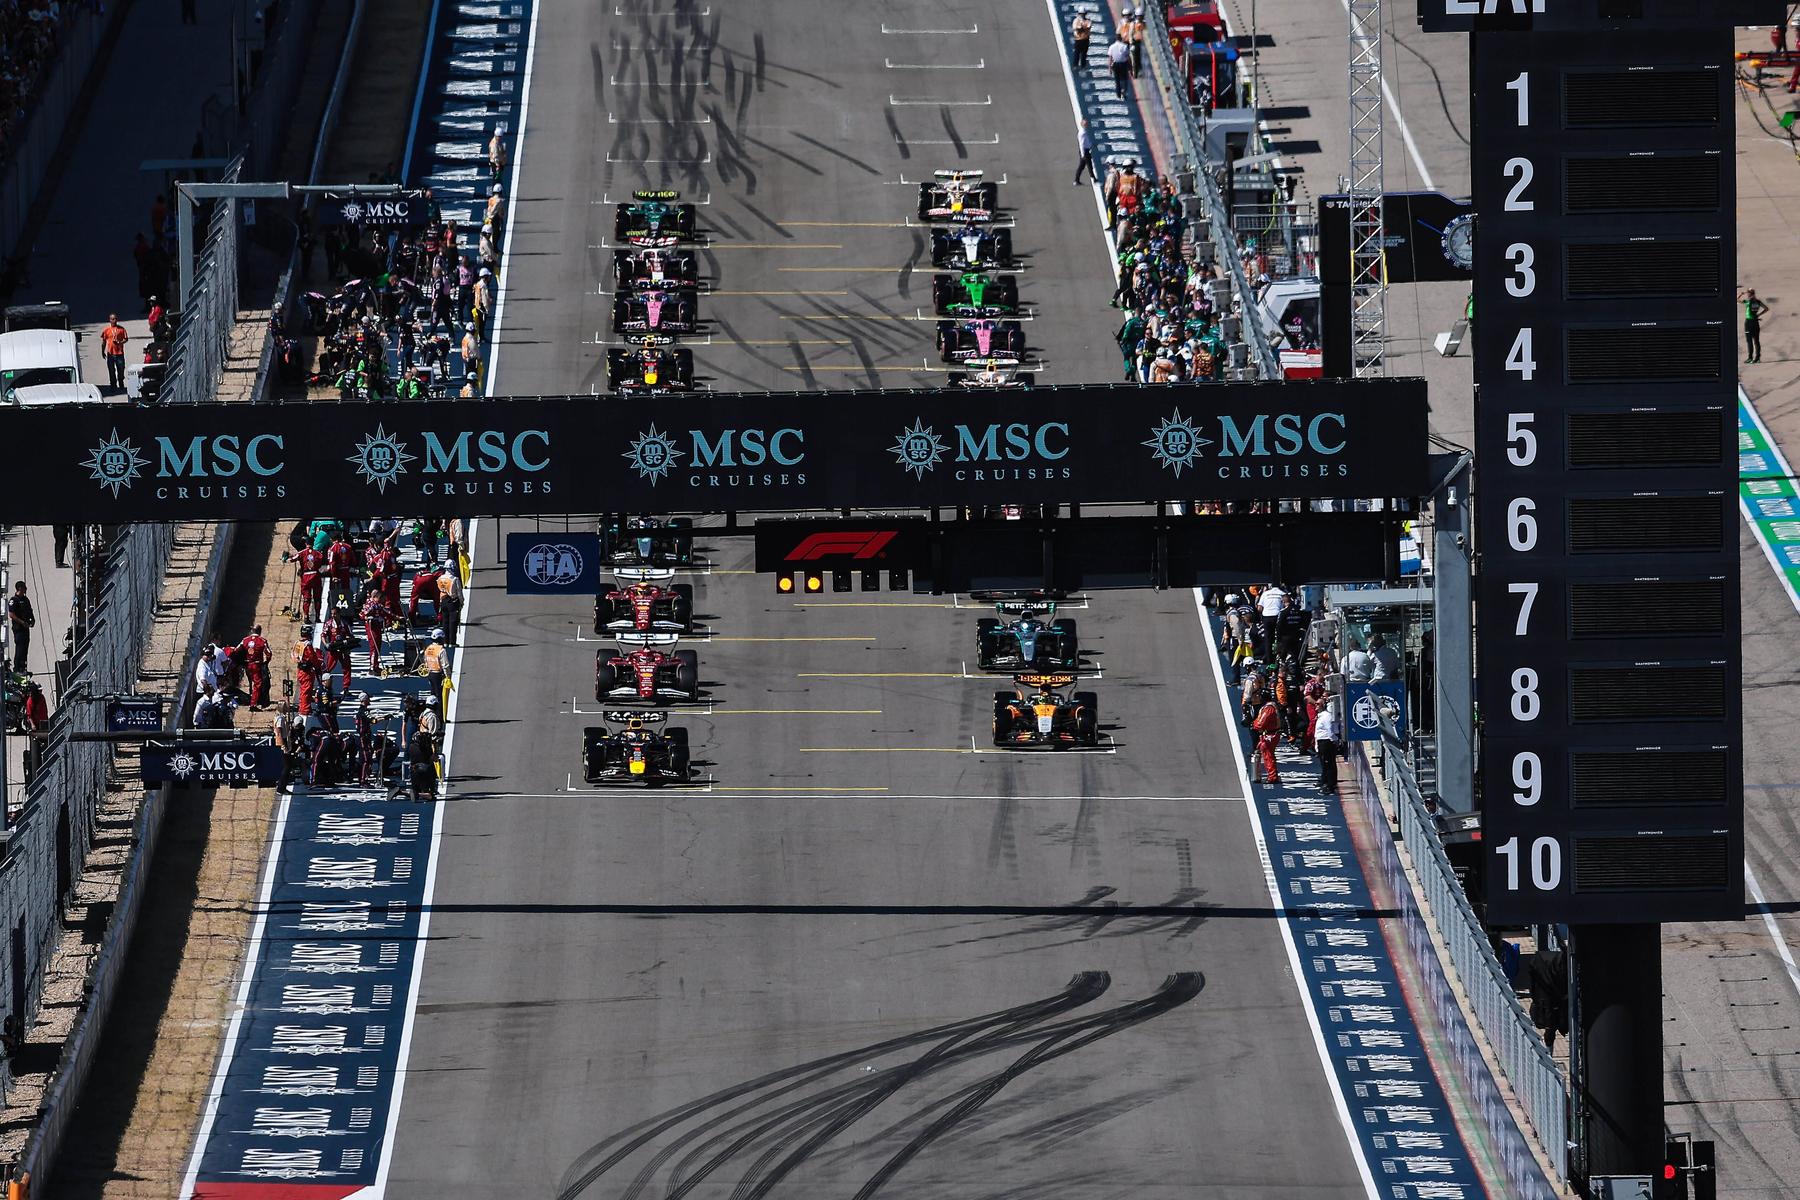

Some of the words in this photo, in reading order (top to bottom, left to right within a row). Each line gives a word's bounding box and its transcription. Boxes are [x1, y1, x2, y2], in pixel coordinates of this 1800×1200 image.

[1507, 72, 1528, 126] 1
[1504, 158, 1533, 211] 2
[366, 202, 408, 216] MSC
[1505, 243, 1535, 297] 3
[1506, 328, 1536, 380] 4
[155, 434, 284, 477] MSC
[421, 430, 550, 472] MSC
[689, 429, 804, 467] MSC
[955, 423, 1069, 461] MSC
[1217, 413, 1346, 456] MSC
[1507, 413, 1536, 466] 5
[423, 482, 550, 494] CRUISES
[690, 474, 805, 486] CRUISES
[956, 468, 1070, 480] CRUISES
[1219, 464, 1346, 478] CRUISES
[157, 486, 285, 499] CRUISES
[1508, 498, 1537, 551] 6
[336, 600, 348, 609] 44
[1509, 583, 1538, 635] 7
[128, 711, 157, 720] MSC
[1511, 668, 1540, 721] 8
[200, 752, 256, 771] MSC
[1512, 752, 1541, 805] 9
[1496, 837, 1561, 890] 10
